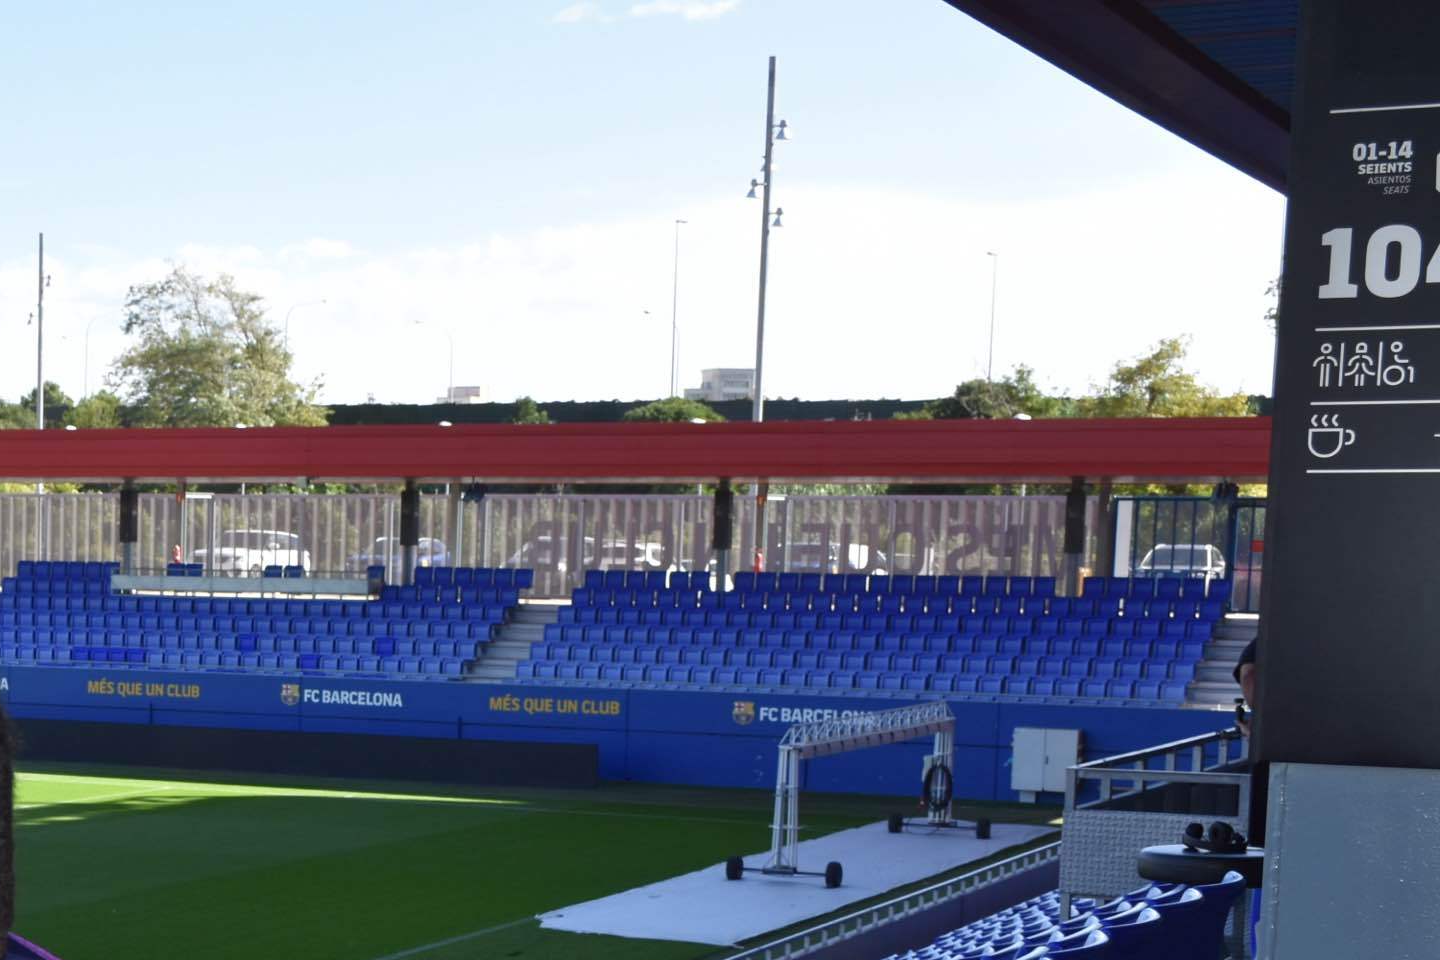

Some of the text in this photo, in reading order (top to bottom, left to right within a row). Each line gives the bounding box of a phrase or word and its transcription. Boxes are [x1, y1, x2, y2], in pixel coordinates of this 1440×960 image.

[1352, 141, 1413, 161] 01-14
[1357, 162, 1412, 175] SEIENTS
[1367, 175, 1411, 185] ASIENTOS
[1383, 185, 1409, 195] SEATS
[1318, 224, 1440, 299] 10
[87, 677, 200, 698] MÉS QUE UN CLUB
[304, 689, 402, 707] FC BARCELONA
[489, 693, 621, 715] MÉS QUE UN CLUB
[760, 707, 778, 722] FC
